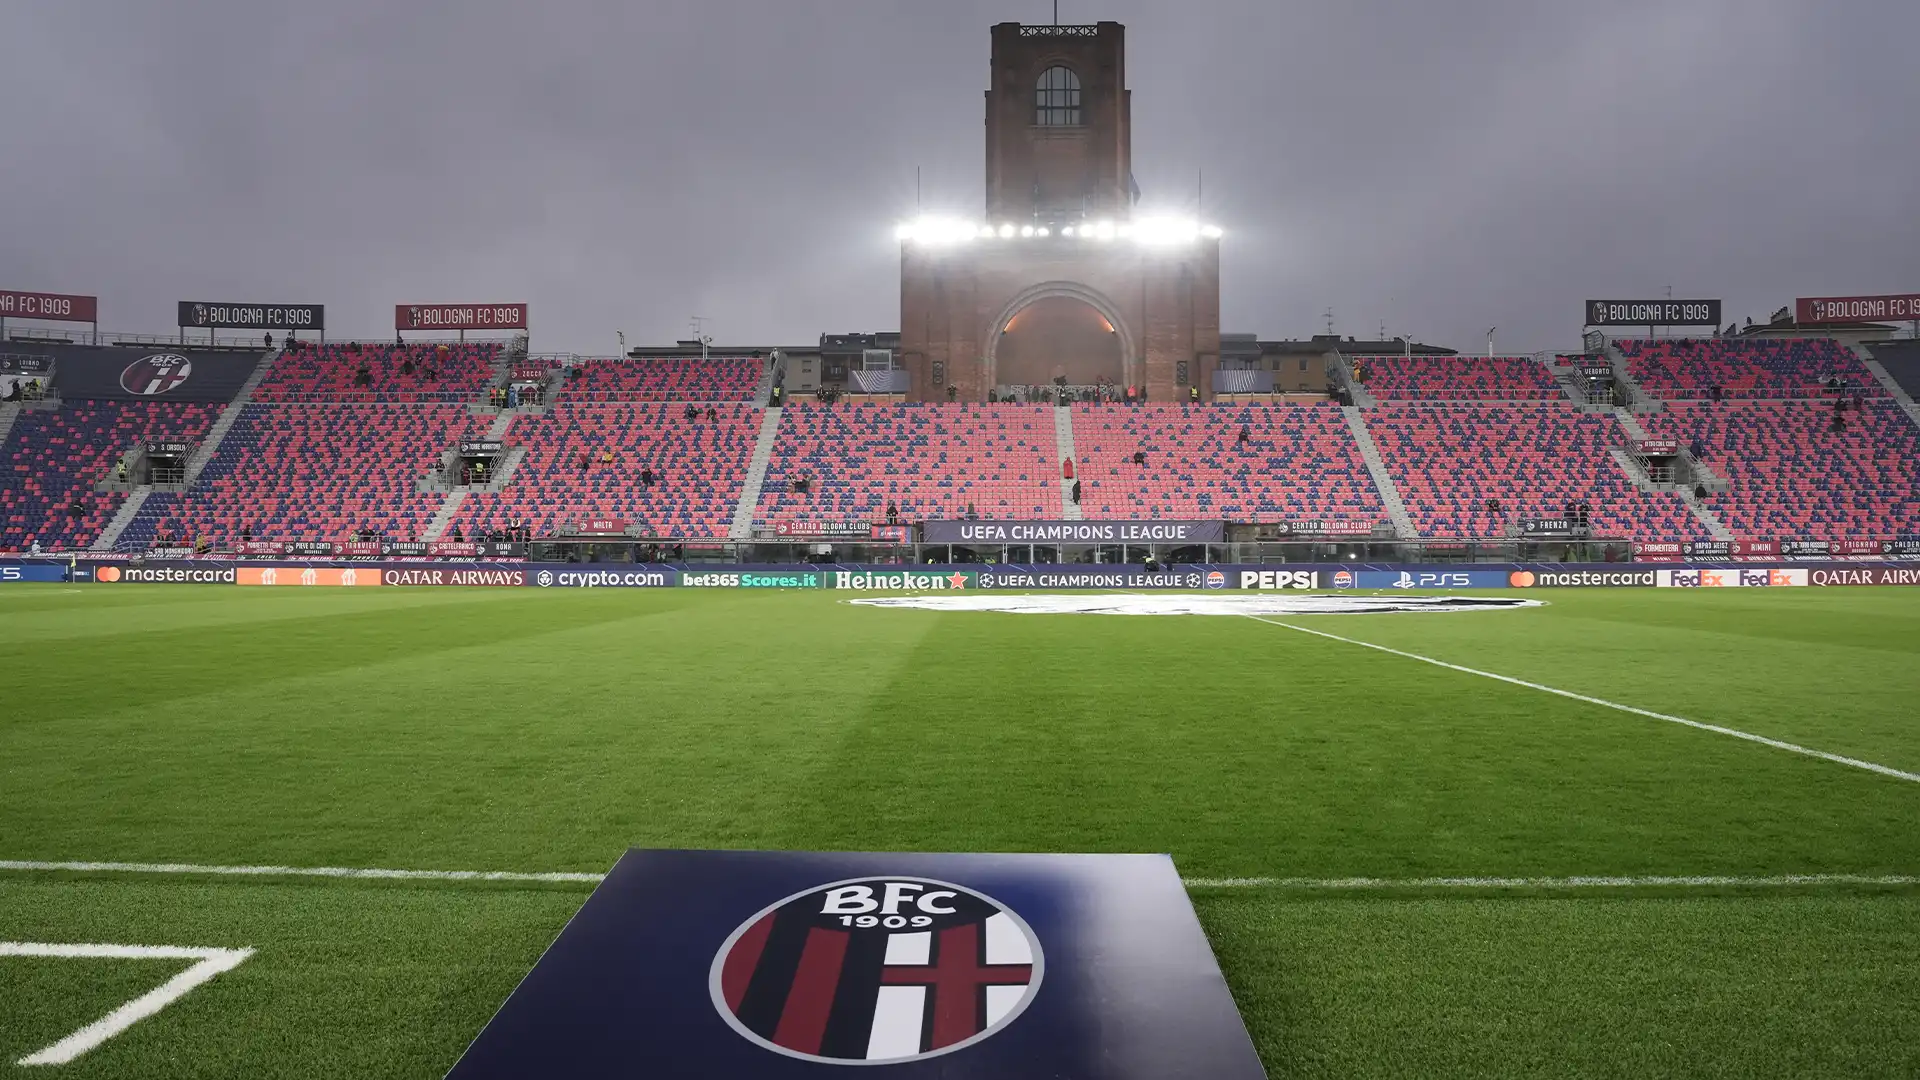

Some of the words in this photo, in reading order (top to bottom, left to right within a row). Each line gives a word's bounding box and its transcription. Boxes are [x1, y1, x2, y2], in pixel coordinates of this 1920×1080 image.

[20, 296, 35, 313] FC
[40, 297, 70, 315] 1909
[1610, 304, 1661, 320] BOLOGNA
[1665, 304, 1680, 320] FC
[1682, 304, 1709, 320] 1909
[1827, 300, 1885, 318] BOLOGNA
[1890, 299, 1905, 316] FC
[210, 307, 263, 323] BOLOGNA
[267, 308, 282, 324] FC
[285, 308, 312, 324] 1909
[423, 308, 473, 324] BOLOGNA
[477, 308, 491, 323] FC
[493, 307, 519, 323] 1909
[150, 355, 182, 364] BFC
[593, 521, 613, 529] MALTA
[791, 522, 817, 530] CENTRO
[819, 522, 847, 530] BOLOGNA
[849, 522, 870, 530] CLUBS
[961, 525, 1006, 539] UEFA
[1011, 525, 1114, 539] CHAMPIONS
[1539, 520, 1568, 529] FAENZA
[295, 542, 308, 550] PIEVE
[438, 542, 475, 550] CASTELFRANCO
[1644, 543, 1679, 552] FORMENTERA
[1750, 543, 1771, 552] RIMINI
[125, 567, 234, 582] mastercard
[385, 570, 443, 586] QATAR
[450, 570, 523, 585] AIRWAYS
[558, 570, 664, 587] crypto.com
[683, 573, 739, 587] bet365
[741, 573, 817, 587] Scores.it
[835, 571, 945, 589] Heineken
[998, 575, 1035, 586] UEFA
[1039, 575, 1123, 586] CHAMPIONS
[1128, 575, 1182, 586] LEAGUE
[1241, 571, 1318, 589] PEPSI
[1420, 573, 1470, 586] PS5
[1540, 570, 1654, 585] mastercard
[1670, 570, 1724, 587] FedEx
[1740, 570, 1792, 587] FedEx
[1812, 569, 1873, 587] QATAR
[819, 882, 957, 915] BFC
[838, 915, 933, 928] 1909
